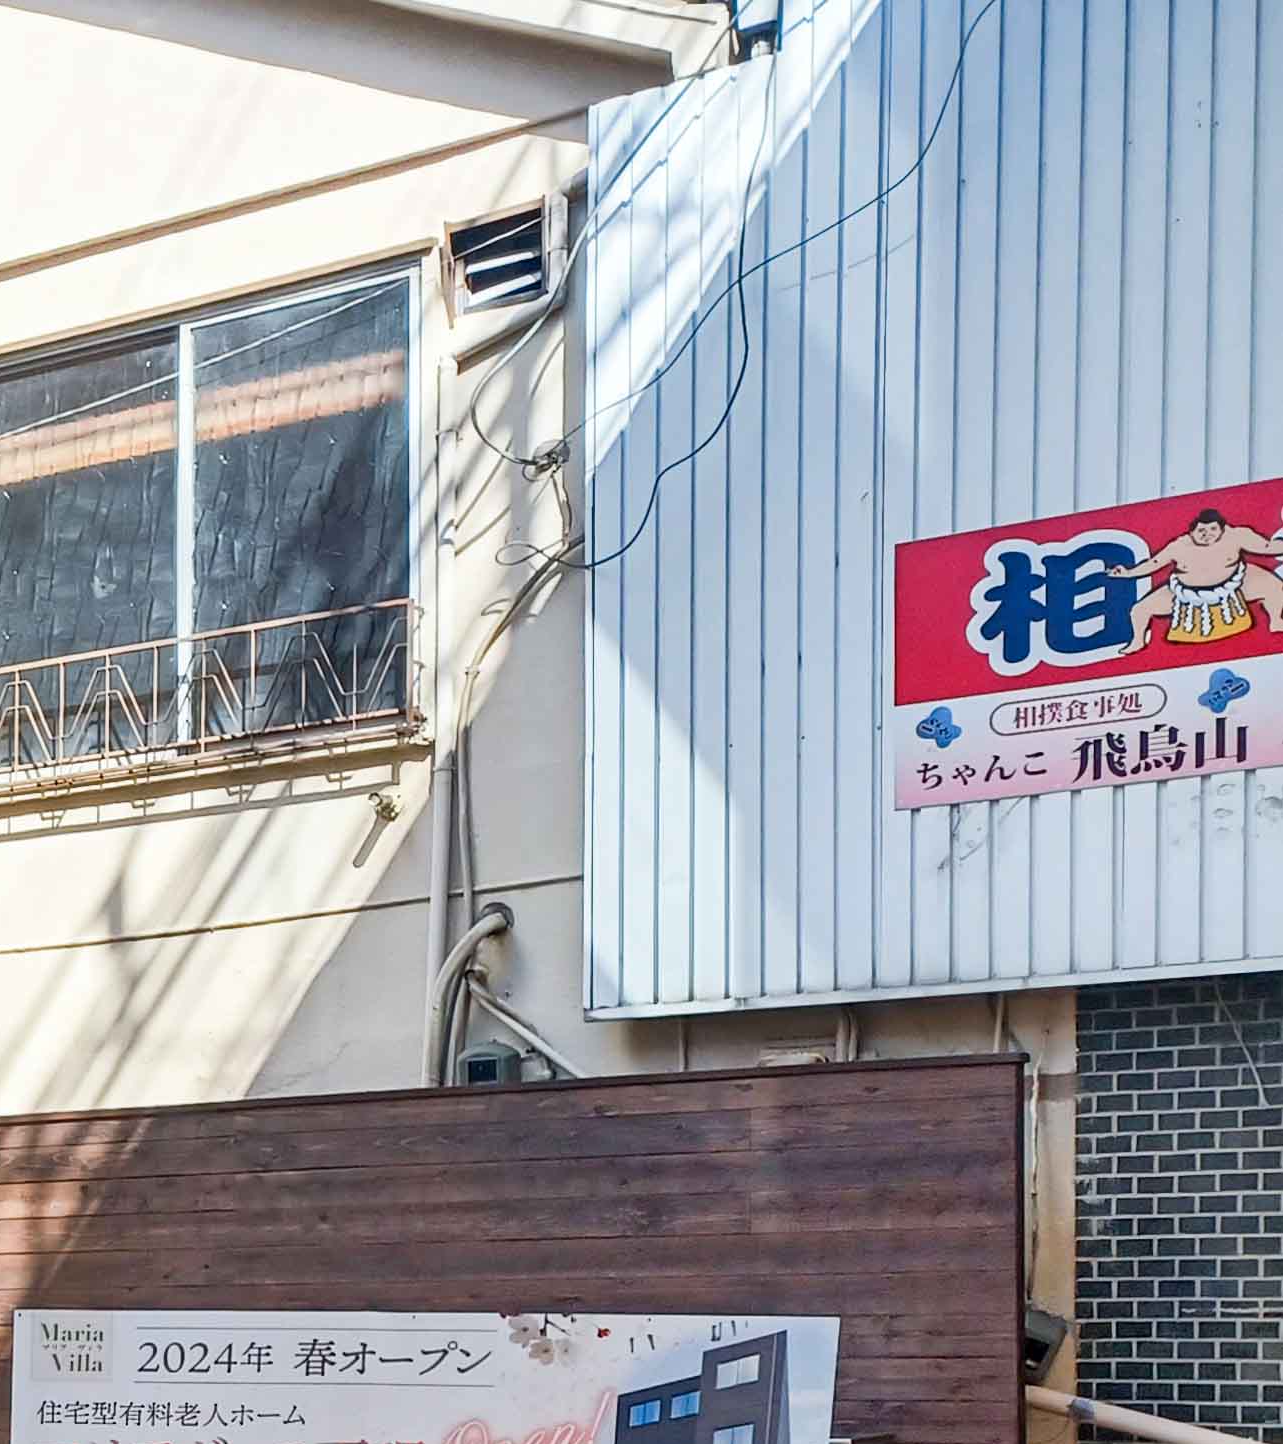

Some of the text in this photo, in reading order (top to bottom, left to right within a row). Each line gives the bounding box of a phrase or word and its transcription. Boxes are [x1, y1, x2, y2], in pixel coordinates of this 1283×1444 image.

[980, 541, 1137, 664] 相
[1012, 692, 1143, 729] 相撲食事処
[916, 717, 1248, 790] ちゃんこ 飛鳥山
[41, 1323, 103, 1342] Maria
[52, 1353, 102, 1372] Villa
[137, 1338, 493, 1377] 2024年 春オープン
[36, 1400, 306, 1427] 住宅型有料老人ホーム
